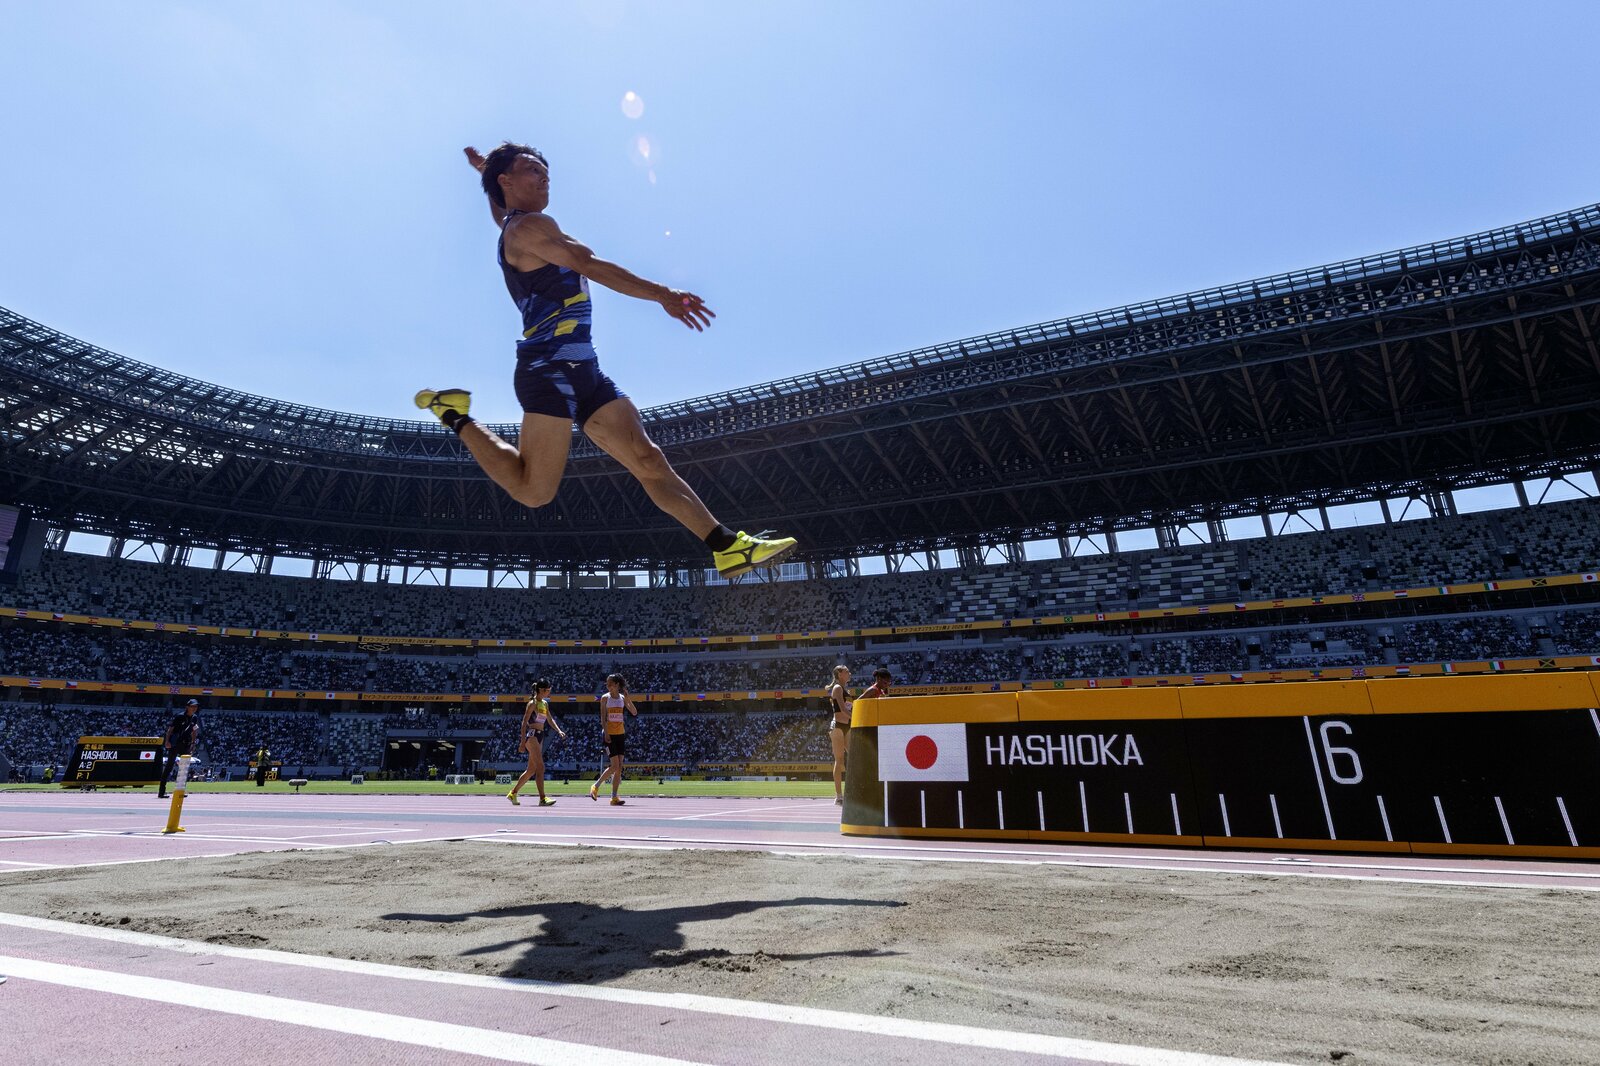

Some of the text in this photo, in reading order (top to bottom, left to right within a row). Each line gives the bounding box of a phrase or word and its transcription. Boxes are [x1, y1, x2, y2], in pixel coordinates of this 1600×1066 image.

[80, 750, 118, 760] HASHIOKA
[985, 733, 1144, 766] HASHIOKA
[1320, 721, 1364, 784] 6
[501, 776, 511, 784] 65
